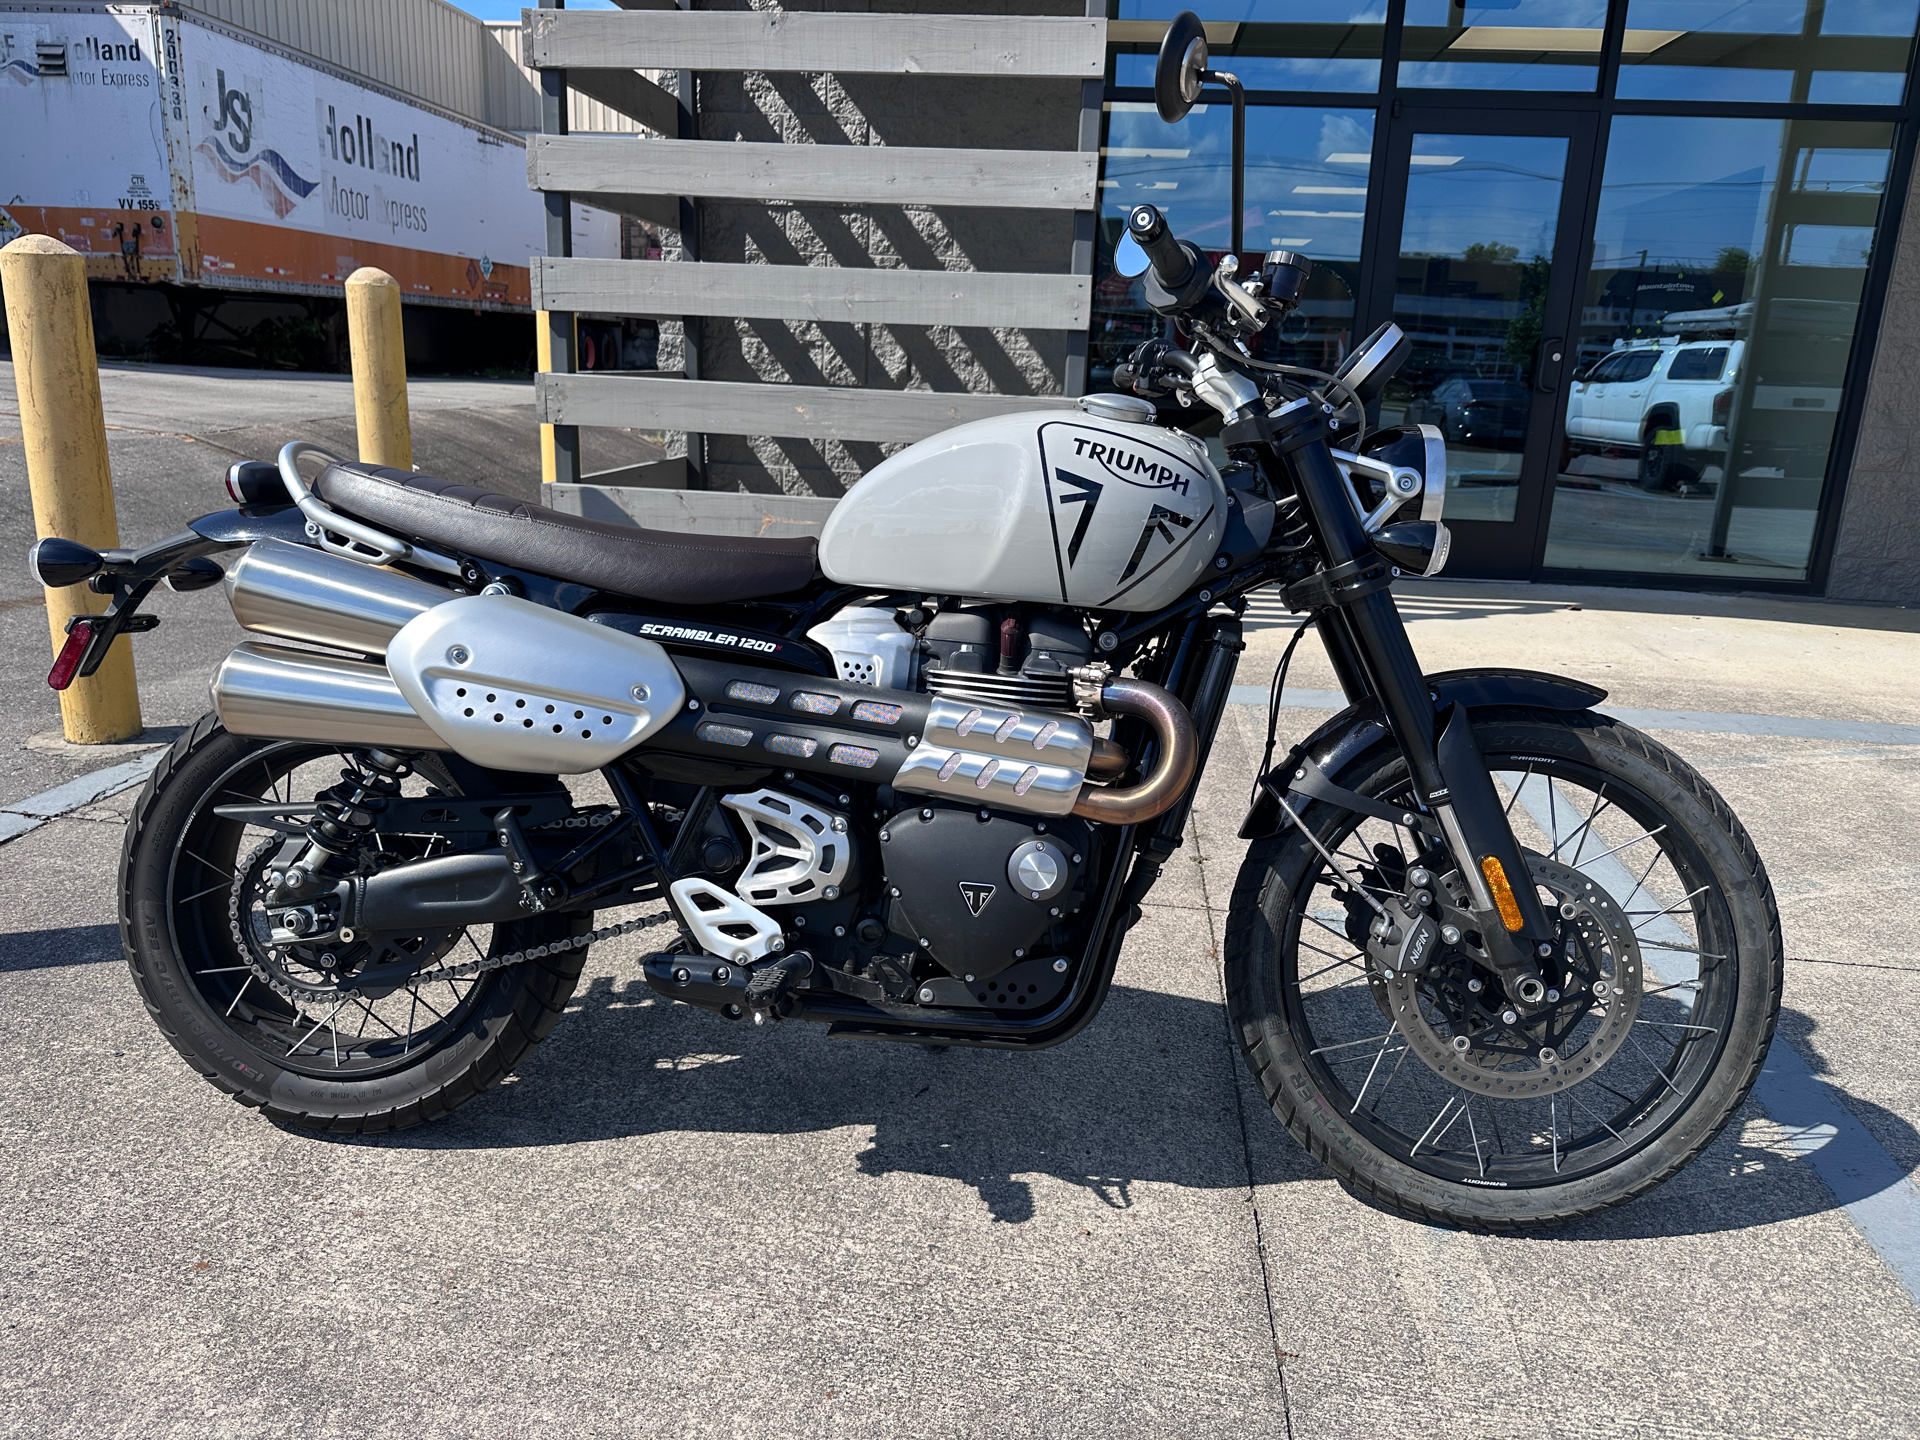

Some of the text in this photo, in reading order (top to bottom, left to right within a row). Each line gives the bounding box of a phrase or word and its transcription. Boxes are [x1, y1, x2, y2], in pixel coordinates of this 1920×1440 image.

[72, 37, 141, 62] olland
[102, 68, 150, 87] Express
[1074, 437, 1190, 497] TRIUMPH
[639, 623, 738, 646] SCRAMBLER
